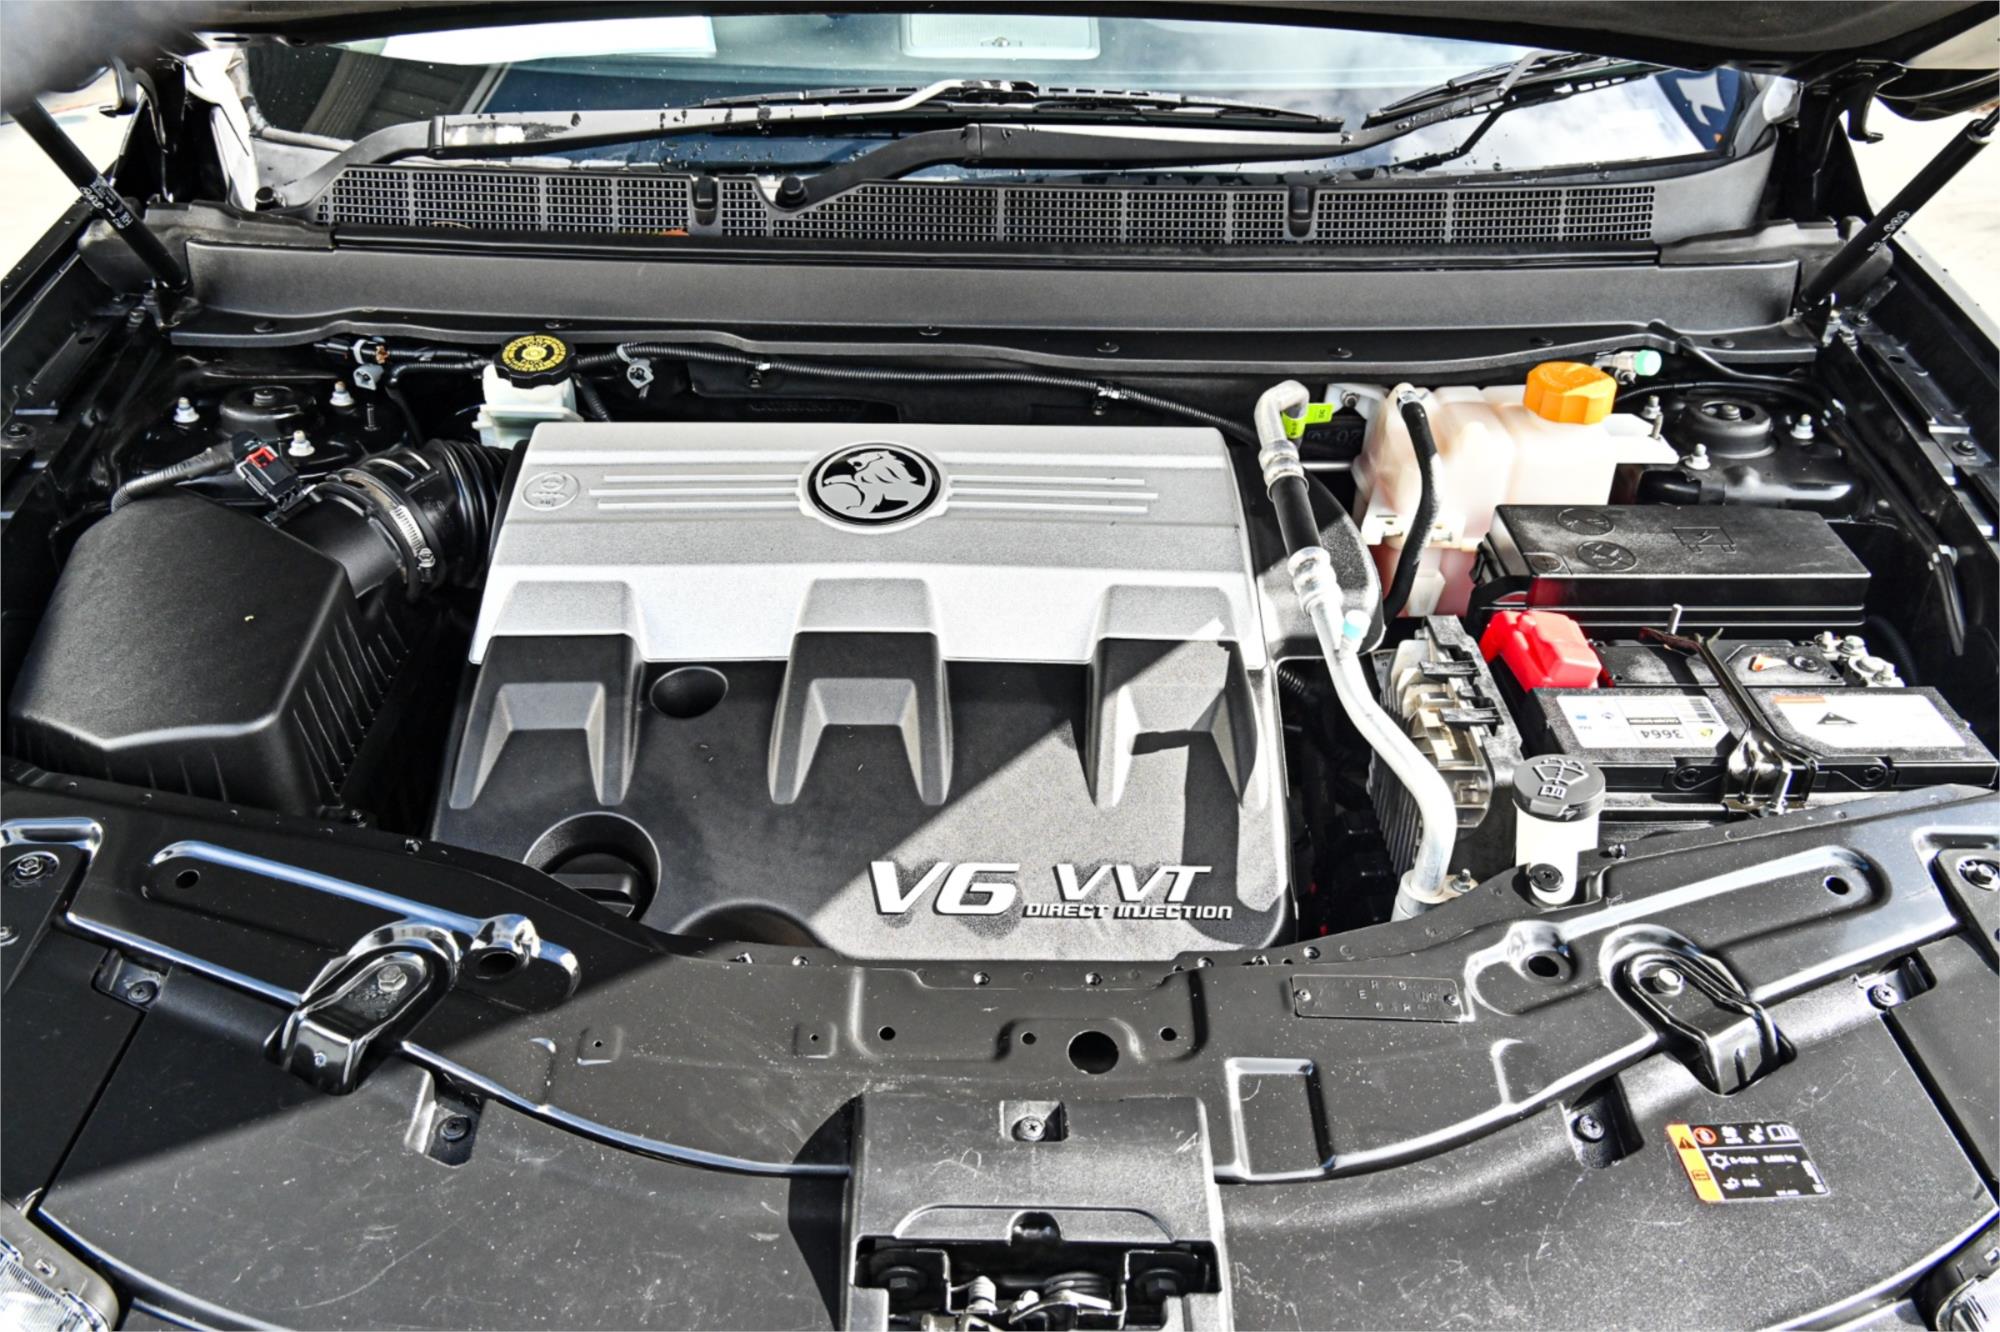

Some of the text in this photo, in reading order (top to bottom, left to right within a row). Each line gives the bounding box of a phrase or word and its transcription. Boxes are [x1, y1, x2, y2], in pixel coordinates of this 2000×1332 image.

[1640, 728, 1684, 740] 3664
[869, 860, 1212, 916] V6 VVT
[1022, 902, 1233, 920] DIRECT INJECTION
